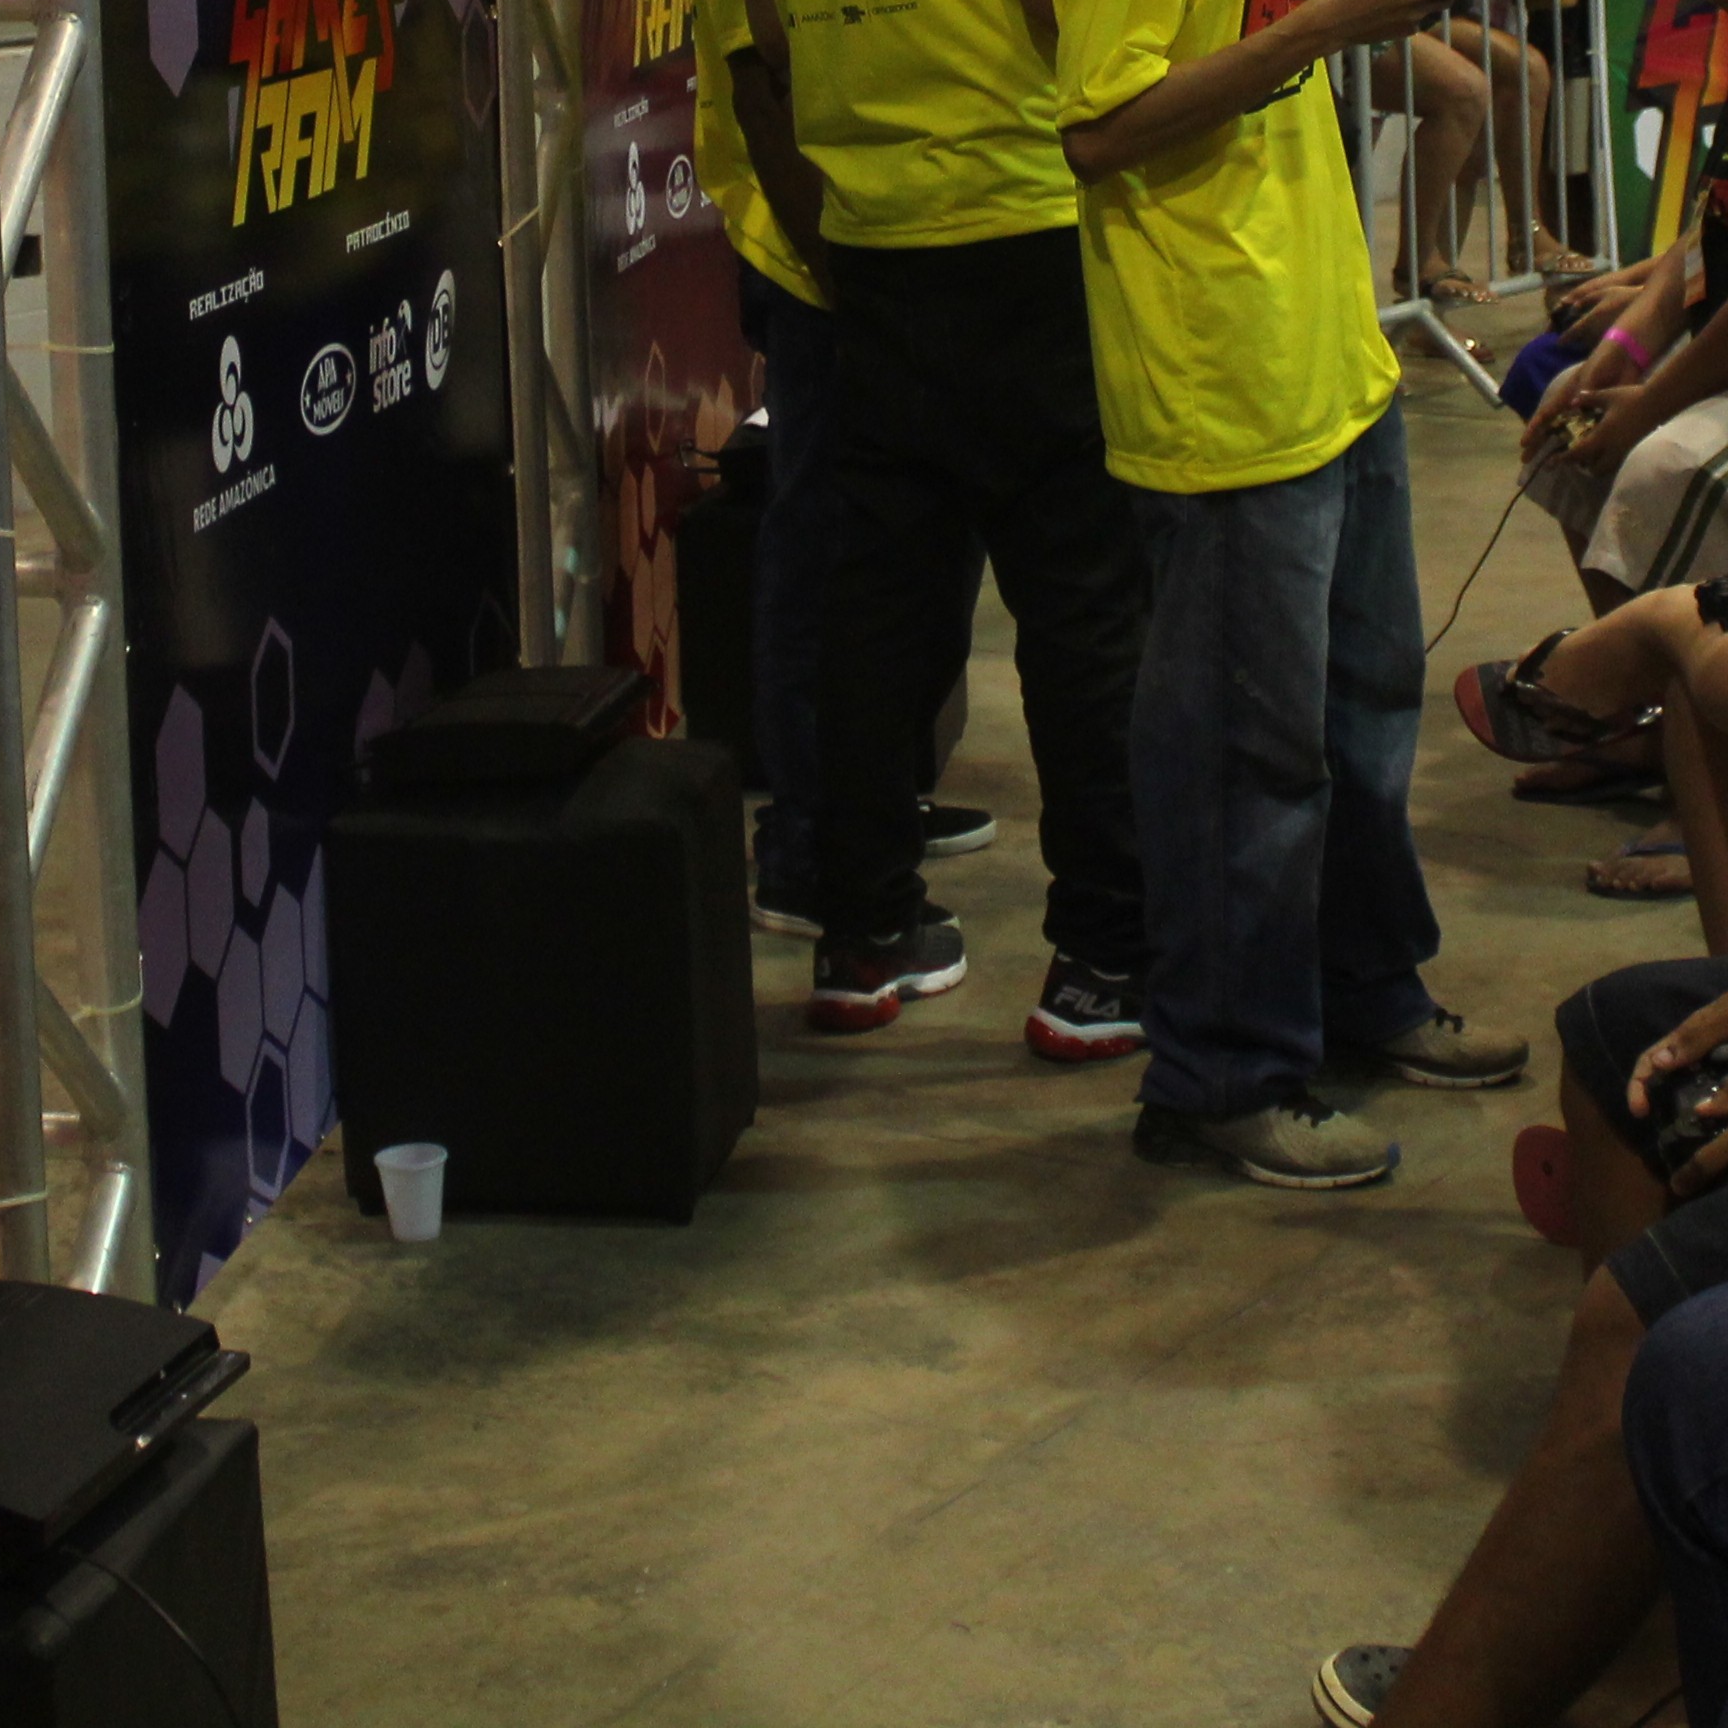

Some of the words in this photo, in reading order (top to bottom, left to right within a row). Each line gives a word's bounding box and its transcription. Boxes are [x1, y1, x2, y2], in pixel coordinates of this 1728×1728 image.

[232, 57, 378, 228] RAM
[345, 209, 411, 254] PATROCÍNIO
[188, 266, 265, 322] REALIZAÇÃO
[316, 355, 339, 393] APA
[368, 316, 398, 376] info
[372, 359, 413, 415] store
[193, 496, 218, 534] REDE
[218, 463, 276, 518] AMAZÔNICA
[1052, 984, 1123, 1020] FILA
